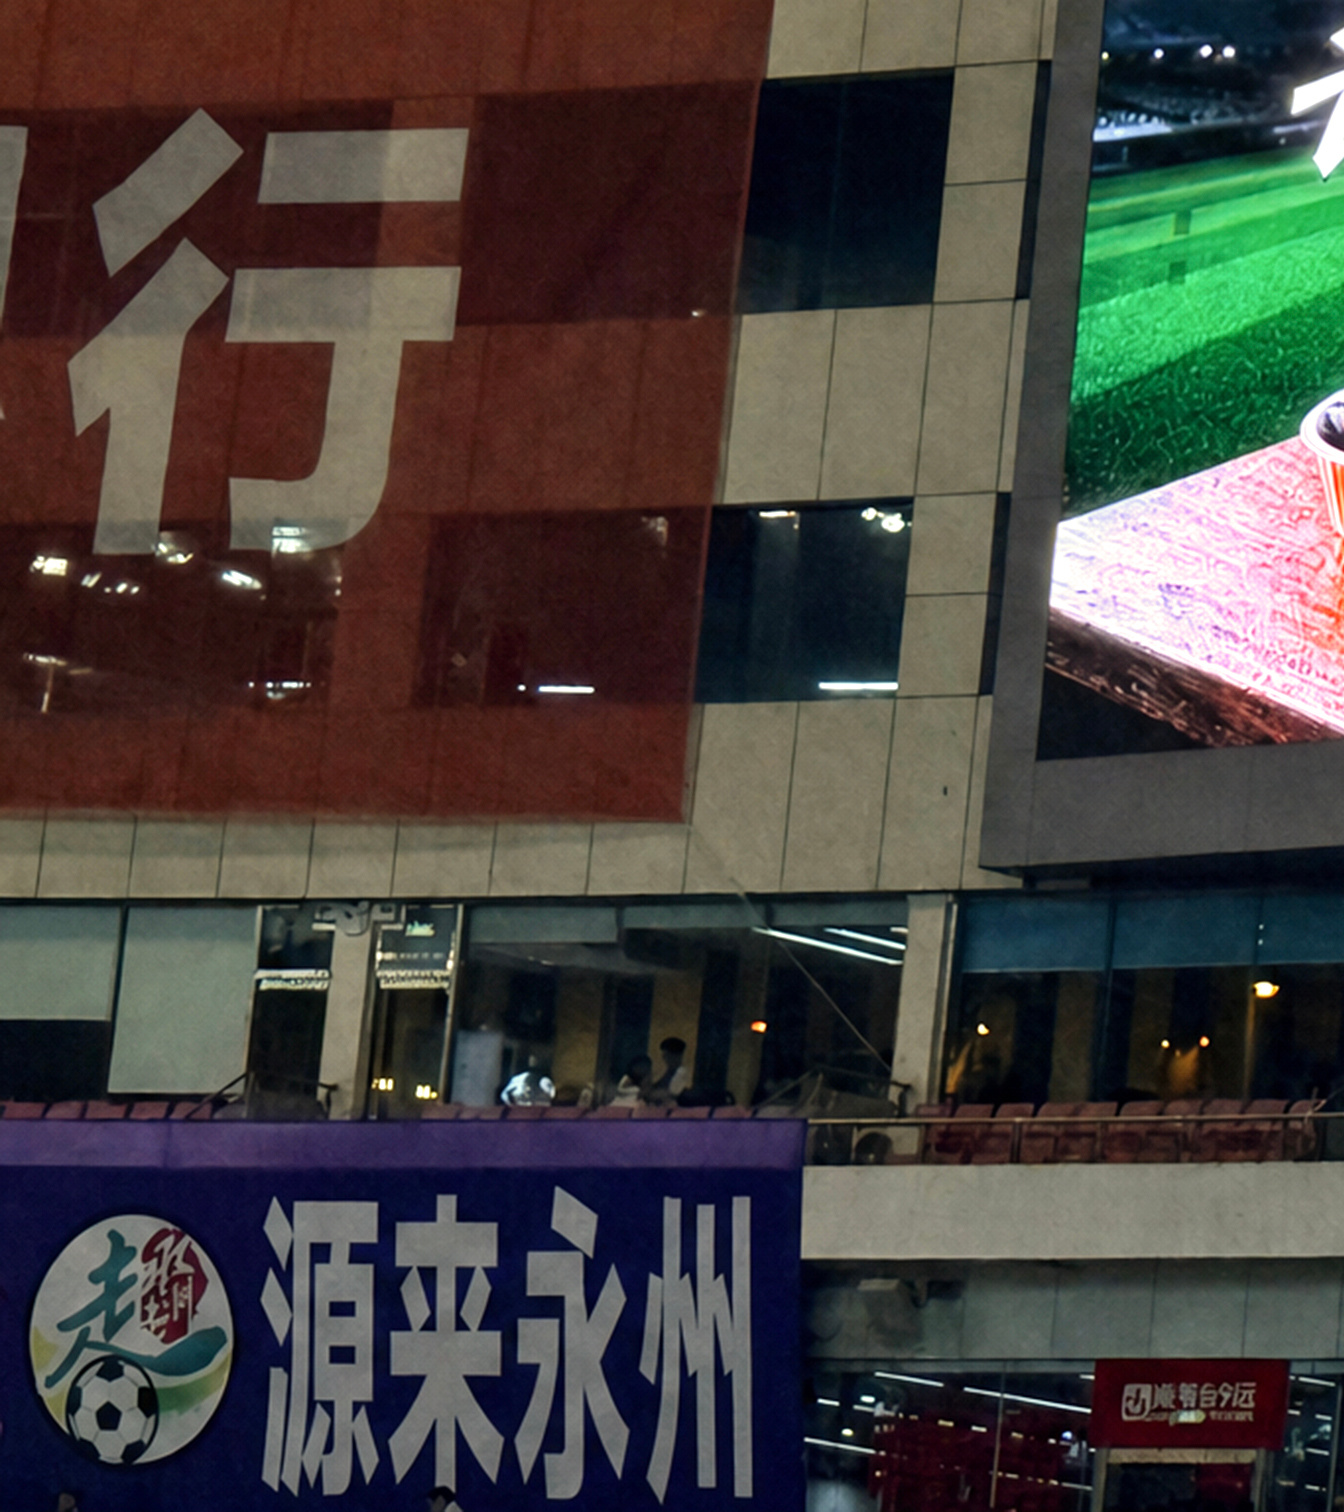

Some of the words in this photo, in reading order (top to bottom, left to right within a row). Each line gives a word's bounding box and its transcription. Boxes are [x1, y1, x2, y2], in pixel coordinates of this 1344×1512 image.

[0, 107, 470, 555] 行
[260, 1187, 755, 1504] 源来永州
